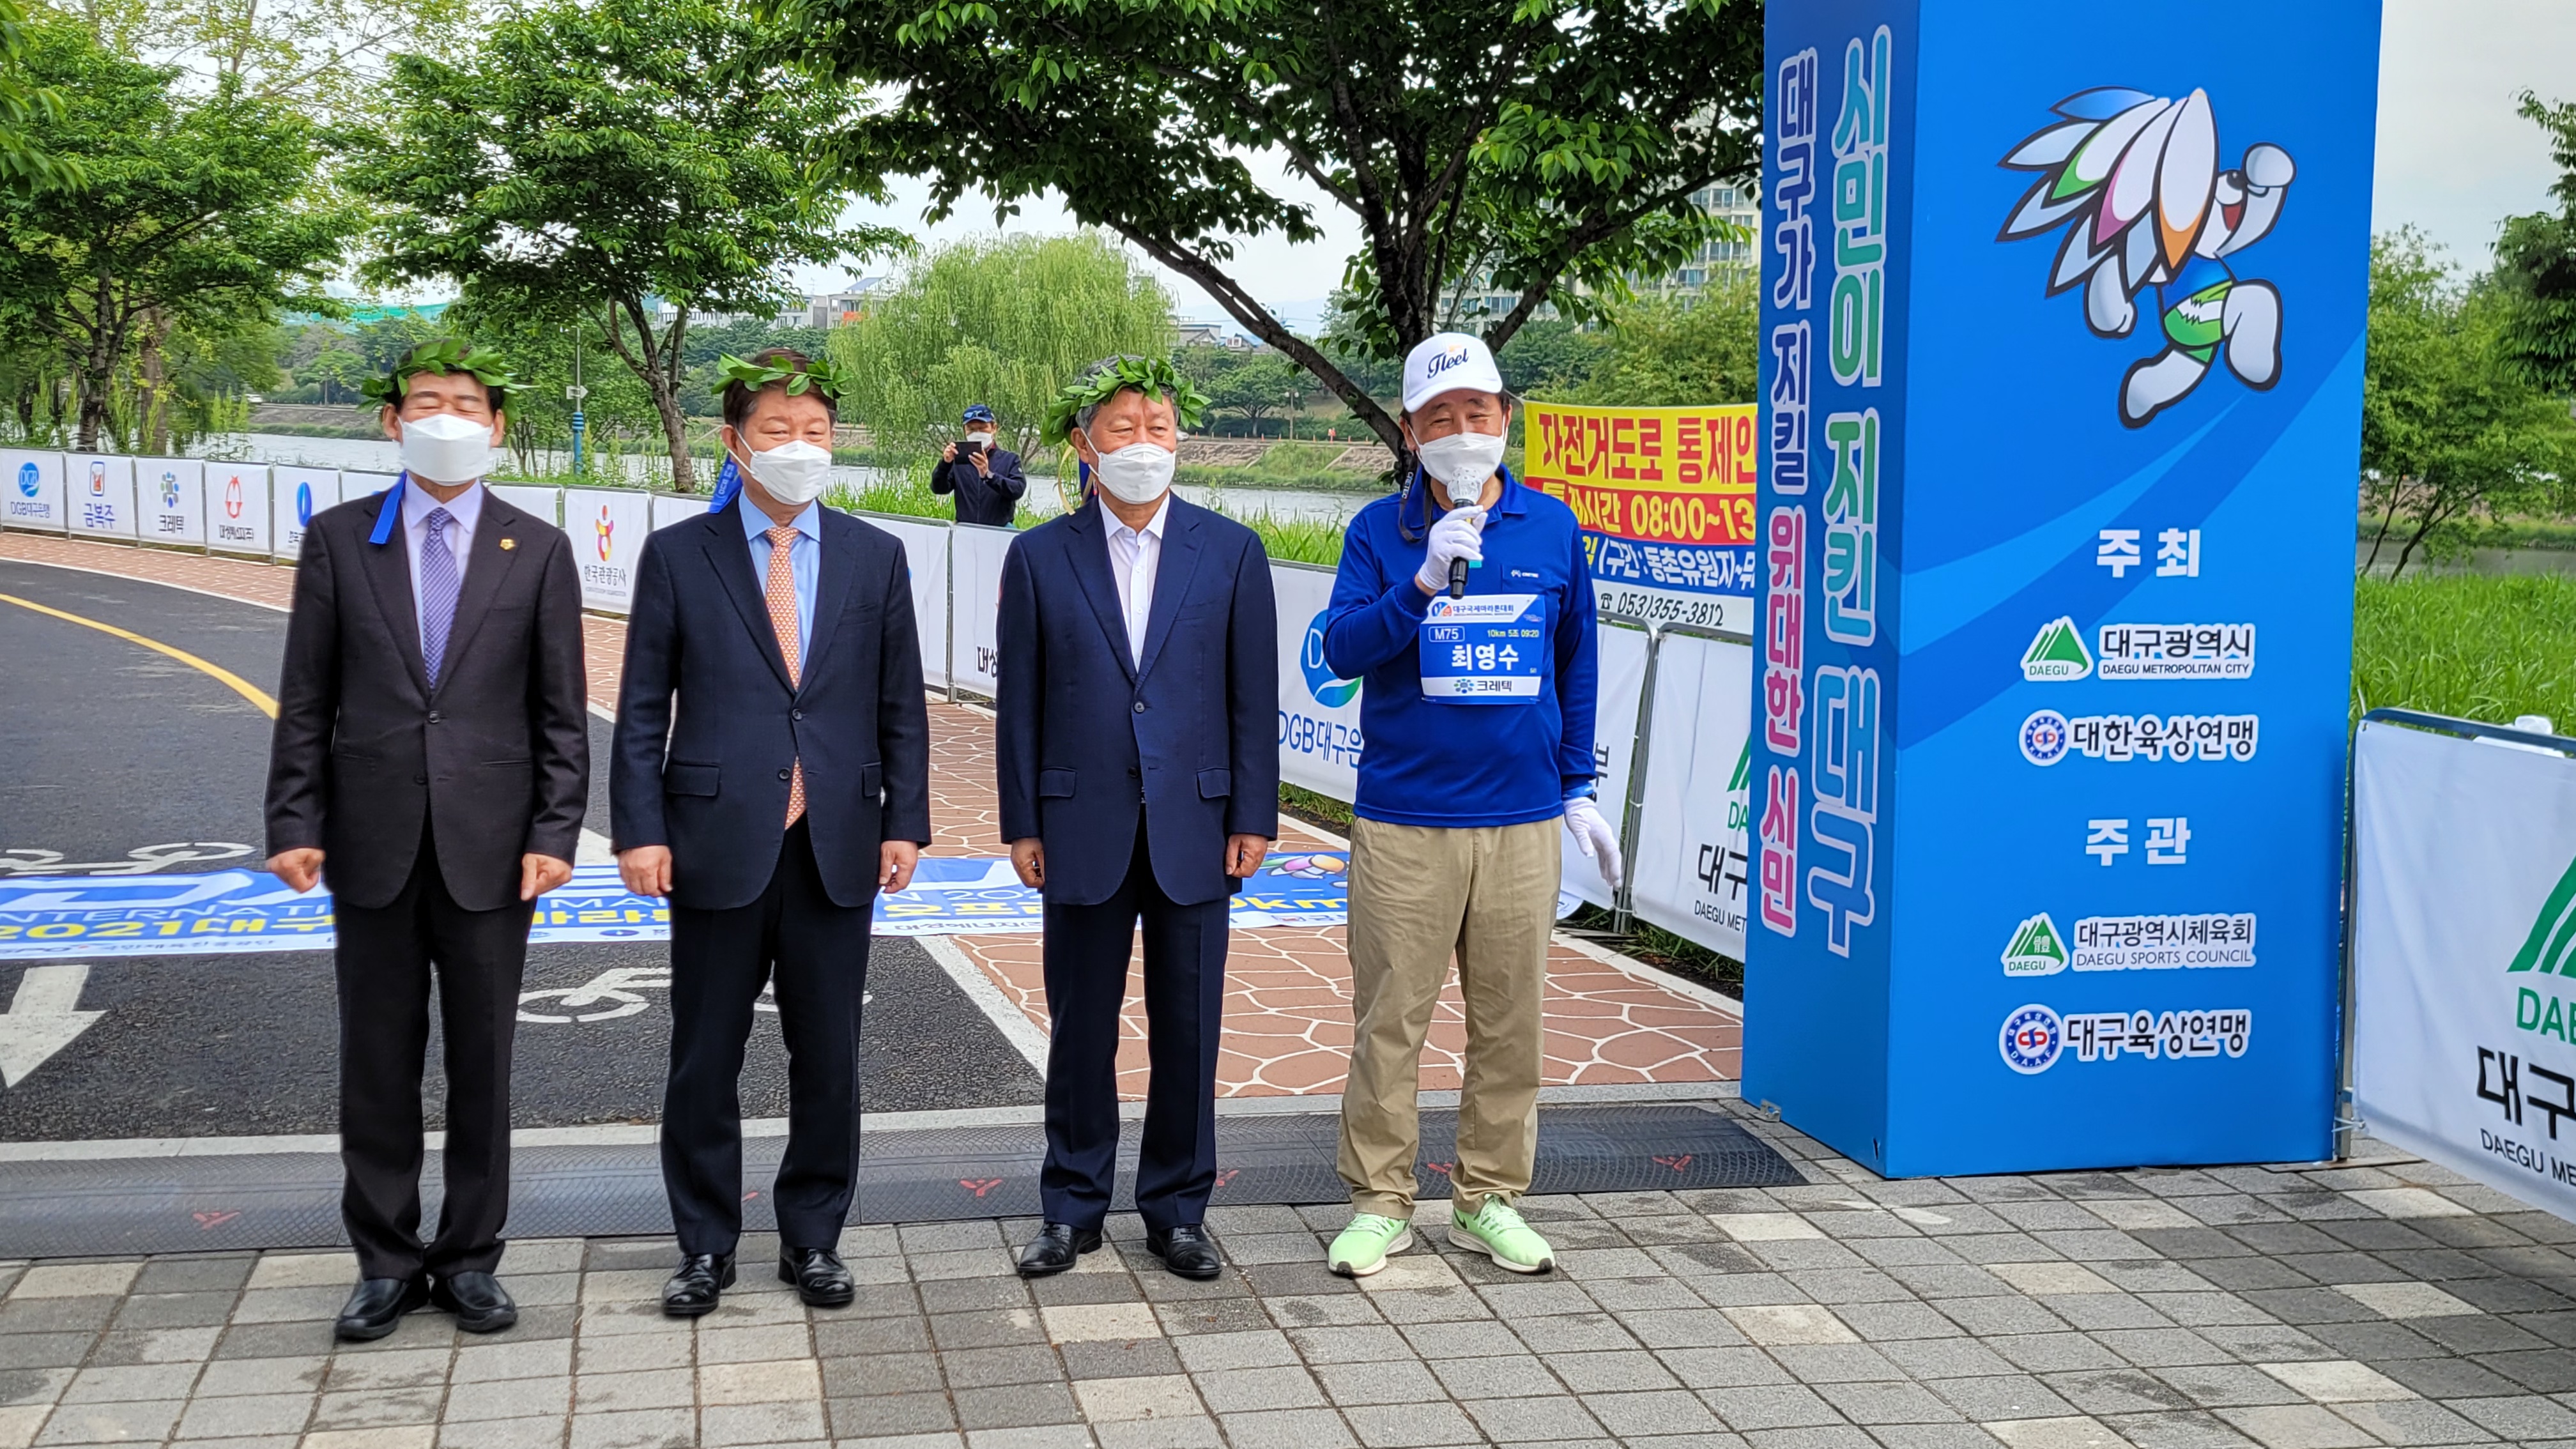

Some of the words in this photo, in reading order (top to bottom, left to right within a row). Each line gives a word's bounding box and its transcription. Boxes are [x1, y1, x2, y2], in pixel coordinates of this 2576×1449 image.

[1774, 47, 1818, 310] 대구가
[1830, 24, 1892, 387] 시민이
[1770, 319, 1811, 495] 지킬
[1538, 413, 1663, 481] 자전거도로
[83, 503, 116, 529] 금복주
[1823, 407, 1880, 647] 지킨
[1617, 592, 1724, 627] 053)355-3812
[1434, 628, 1459, 640] M75
[1763, 505, 1807, 758] 위대한
[2103, 628, 2251, 658] 대구광역시
[1452, 643, 1519, 671] 최영수
[2028, 665, 2069, 676] DAEGU
[2103, 664, 2140, 674] DAEGU
[2143, 664, 2221, 674] METROPOLITAN
[2225, 663, 2250, 674] CITY
[1476, 680, 1512, 692] 크레텍
[2073, 719, 2254, 756] 대한육상연맹
[1807, 664, 1880, 958] 대구
[1759, 764, 1799, 937] 시민
[1695, 900, 1724, 925] DAEGU
[2079, 918, 2251, 947] 대구광역시체육회
[2008, 961, 2046, 971] DAEGU
[2076, 953, 2126, 966] DAEGU
[2131, 951, 2181, 965] SPORTS
[2186, 949, 2252, 963] COUNCIL
[2067, 1015, 2246, 1055] 대구육상연맹
[2477, 1045, 2576, 1141] 대구
[2480, 1128, 2544, 1174] DAEGU
